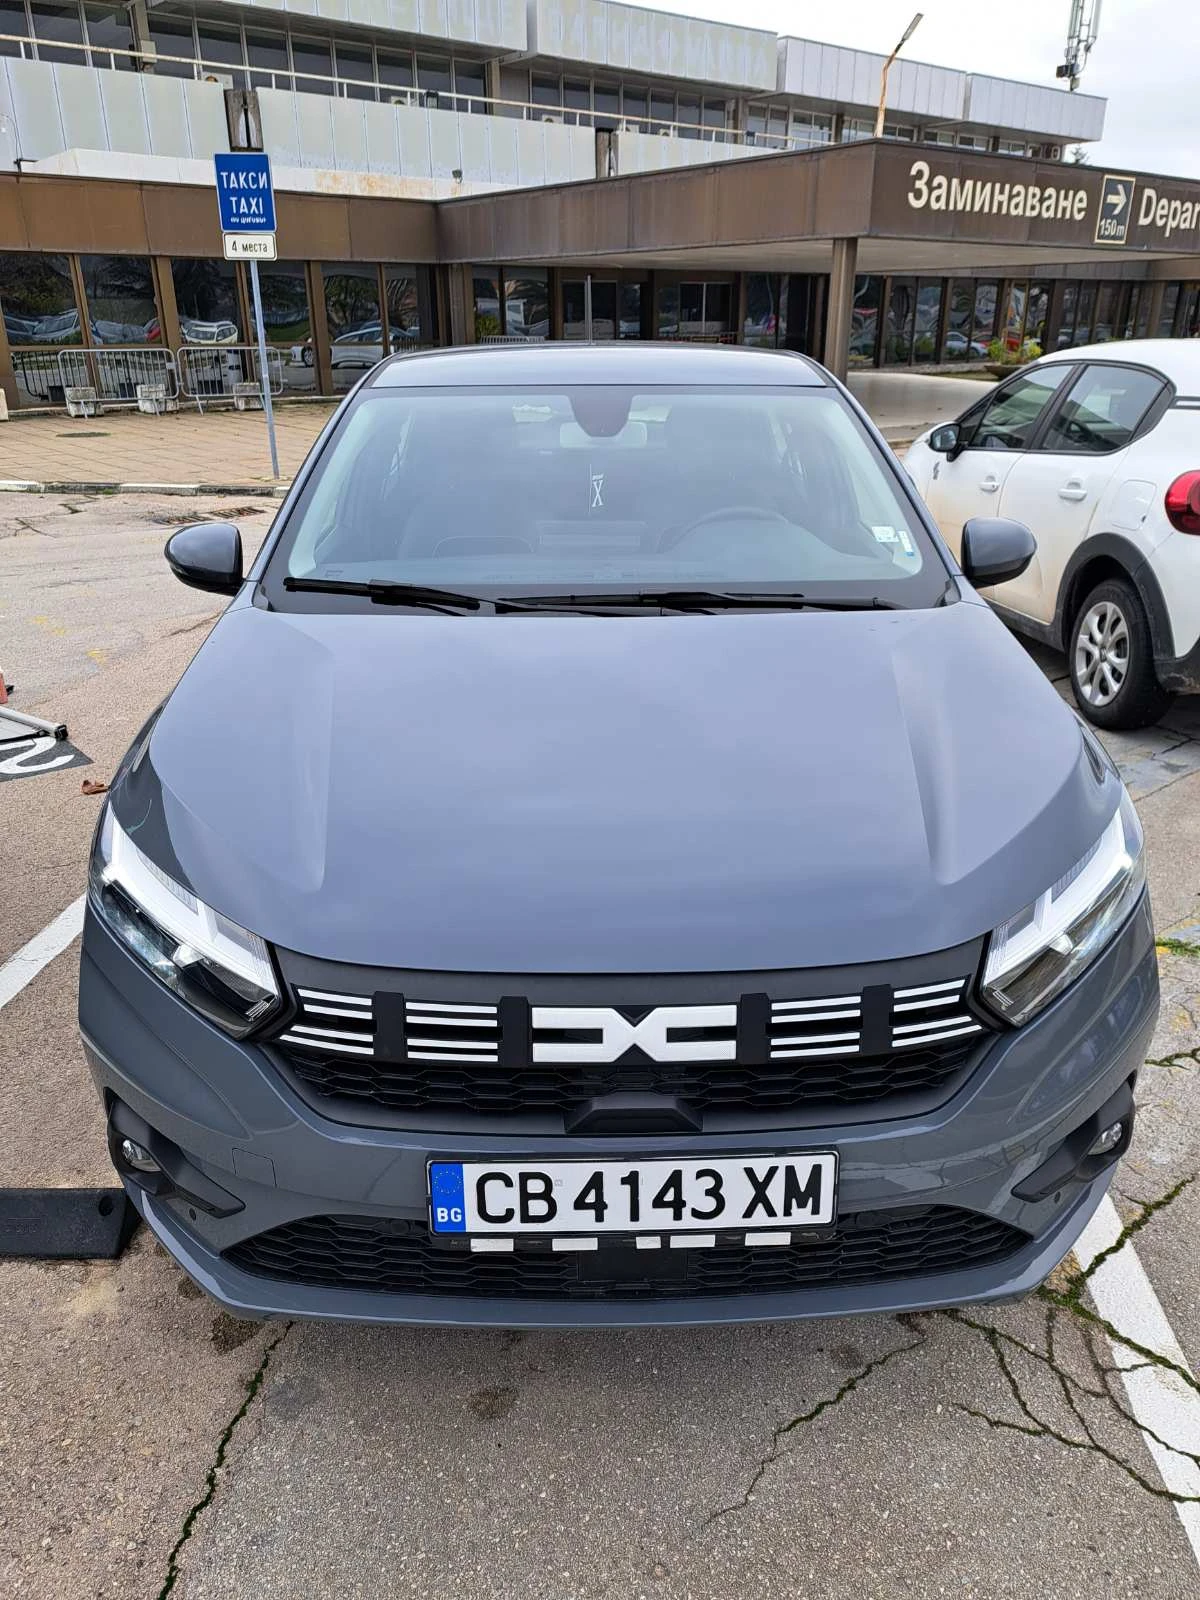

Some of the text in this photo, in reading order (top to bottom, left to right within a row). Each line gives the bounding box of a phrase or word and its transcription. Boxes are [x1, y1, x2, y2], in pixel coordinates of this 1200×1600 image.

[220, 171, 268, 190] ТАКСИ
[907, 160, 1088, 221] Заминаване
[229, 197, 263, 214] TAXI
[232, 240, 268, 253] 4 места
[476, 1164, 822, 1224] CB 4143 XM
[436, 1207, 463, 1223] BG
